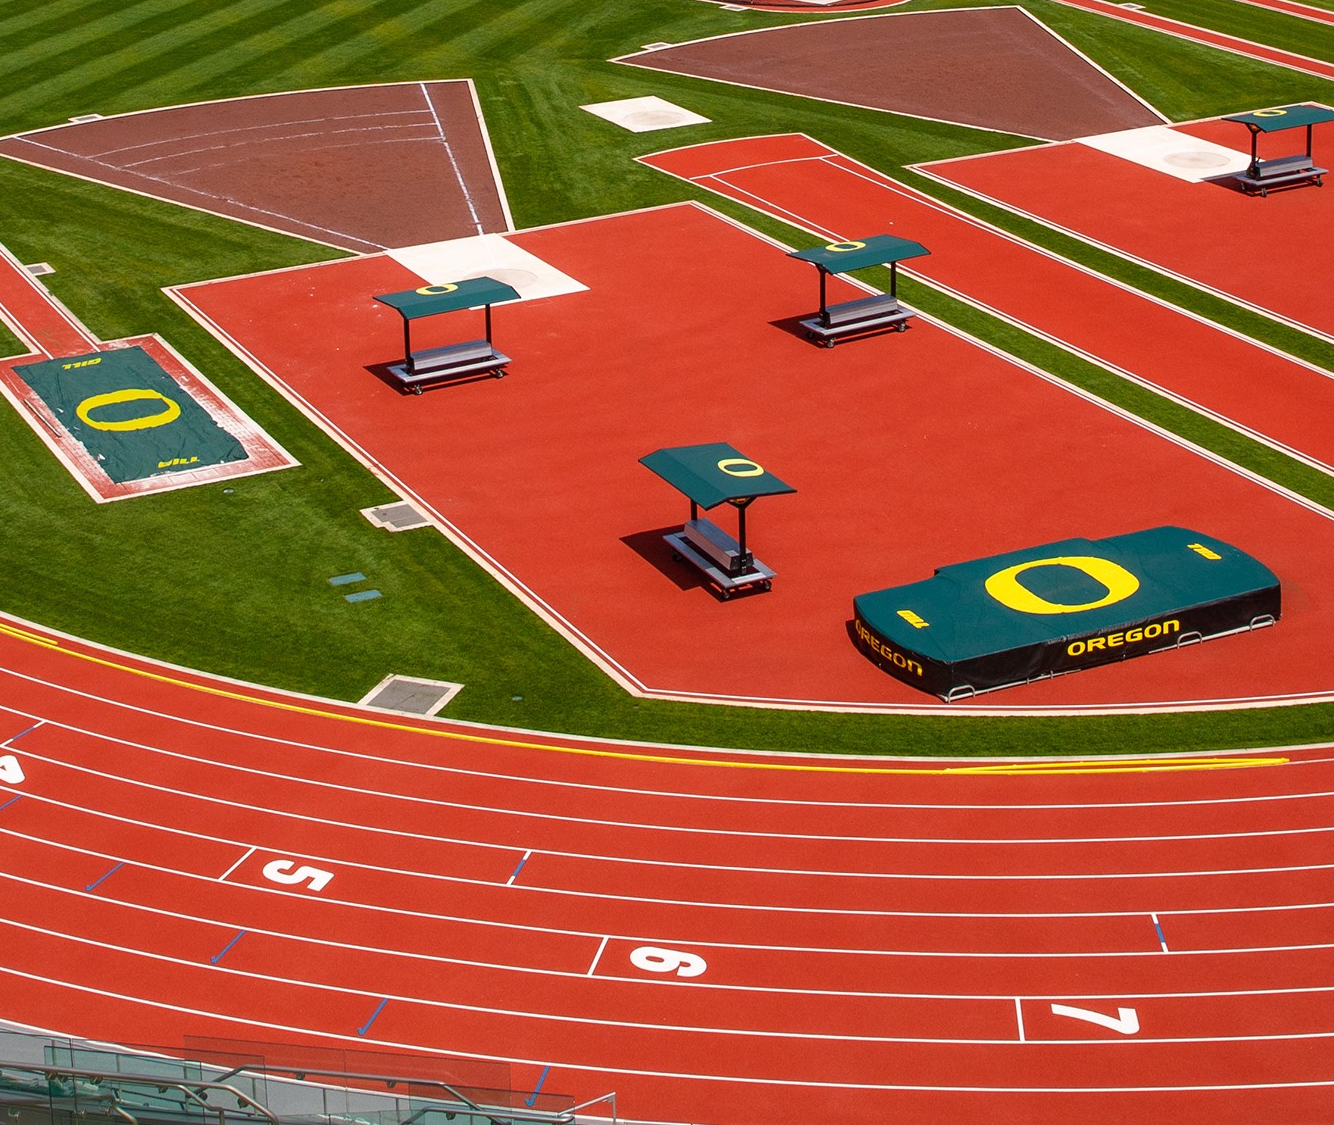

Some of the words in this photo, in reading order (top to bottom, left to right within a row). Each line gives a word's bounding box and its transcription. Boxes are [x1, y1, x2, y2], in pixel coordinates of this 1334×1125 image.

[62, 358, 102, 370] GILL
[76, 388, 181, 431] O
[717, 458, 764, 477] O
[985, 557, 1139, 614] O
[855, 619, 923, 677] OREGON
[1067, 619, 1180, 657] OREGON
[262, 859, 335, 892] 5
[629, 946, 708, 977] 6
[1051, 1003, 1140, 1035] 7
